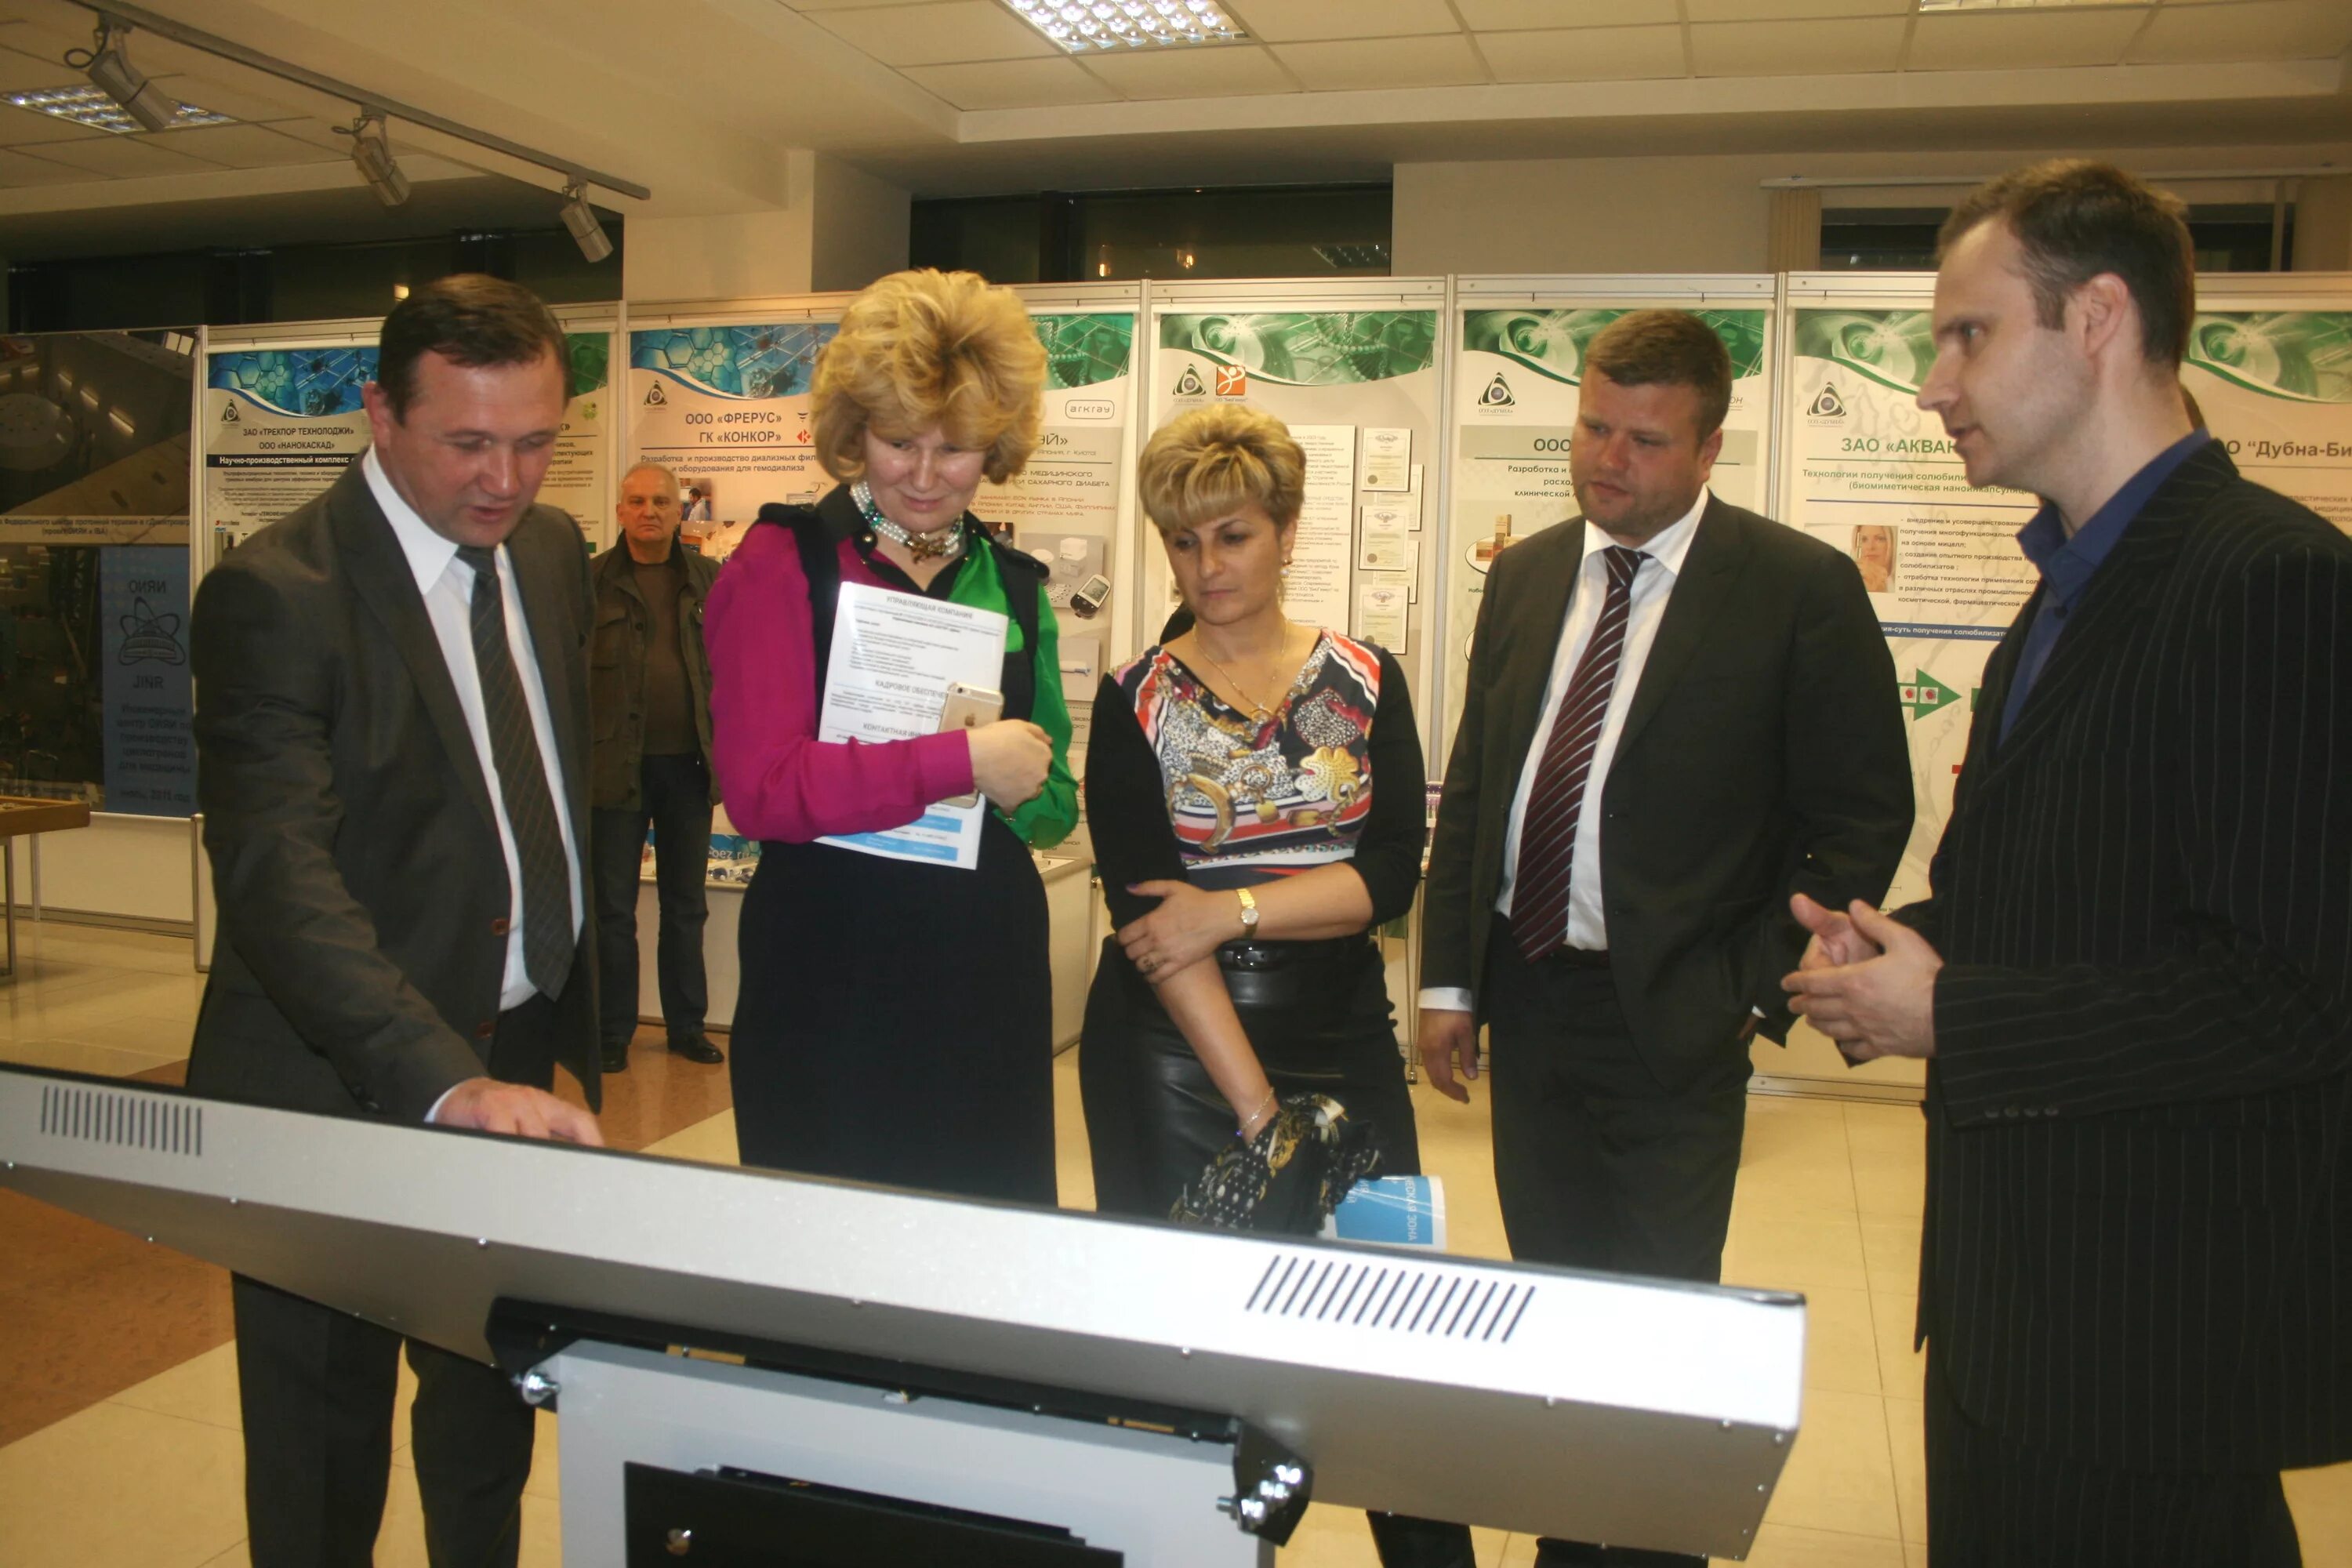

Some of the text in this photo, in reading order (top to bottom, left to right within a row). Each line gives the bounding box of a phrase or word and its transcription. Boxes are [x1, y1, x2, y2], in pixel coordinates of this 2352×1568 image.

[685, 412, 782, 425] ООО «ФРЕРУС»
[298, 427, 354, 436] ТЕХНОЛОДЖИ»
[699, 431, 782, 443] ГК «КОНКОР»
[278, 441, 335, 450] «НАНОКАСКАД»
[1842, 437, 1880, 452] ЗАО
[220, 456, 313, 465] Научно-производственный
[641, 455, 683, 463] Разработка
[695, 455, 750, 463] производство
[753, 464, 804, 473] гемодиализа
[1508, 465, 1559, 474] Разработка
[1803, 469, 1858, 479] Технологии
[1860, 472, 1913, 481] получения
[1849, 481, 1940, 492] (биомиметическая
[129, 580, 166, 593] ОИЯИ
[886, 596, 973, 619] УПРАВЛЯЮЩАЯ КОМПАНИЯ
[1953, 598, 2020, 607] фармацевтической
[132, 675, 165, 689] JINR
[875, 680, 911, 692] КАДРОВОЕ
[863, 723, 907, 736] КОНТАКТНАЯ
